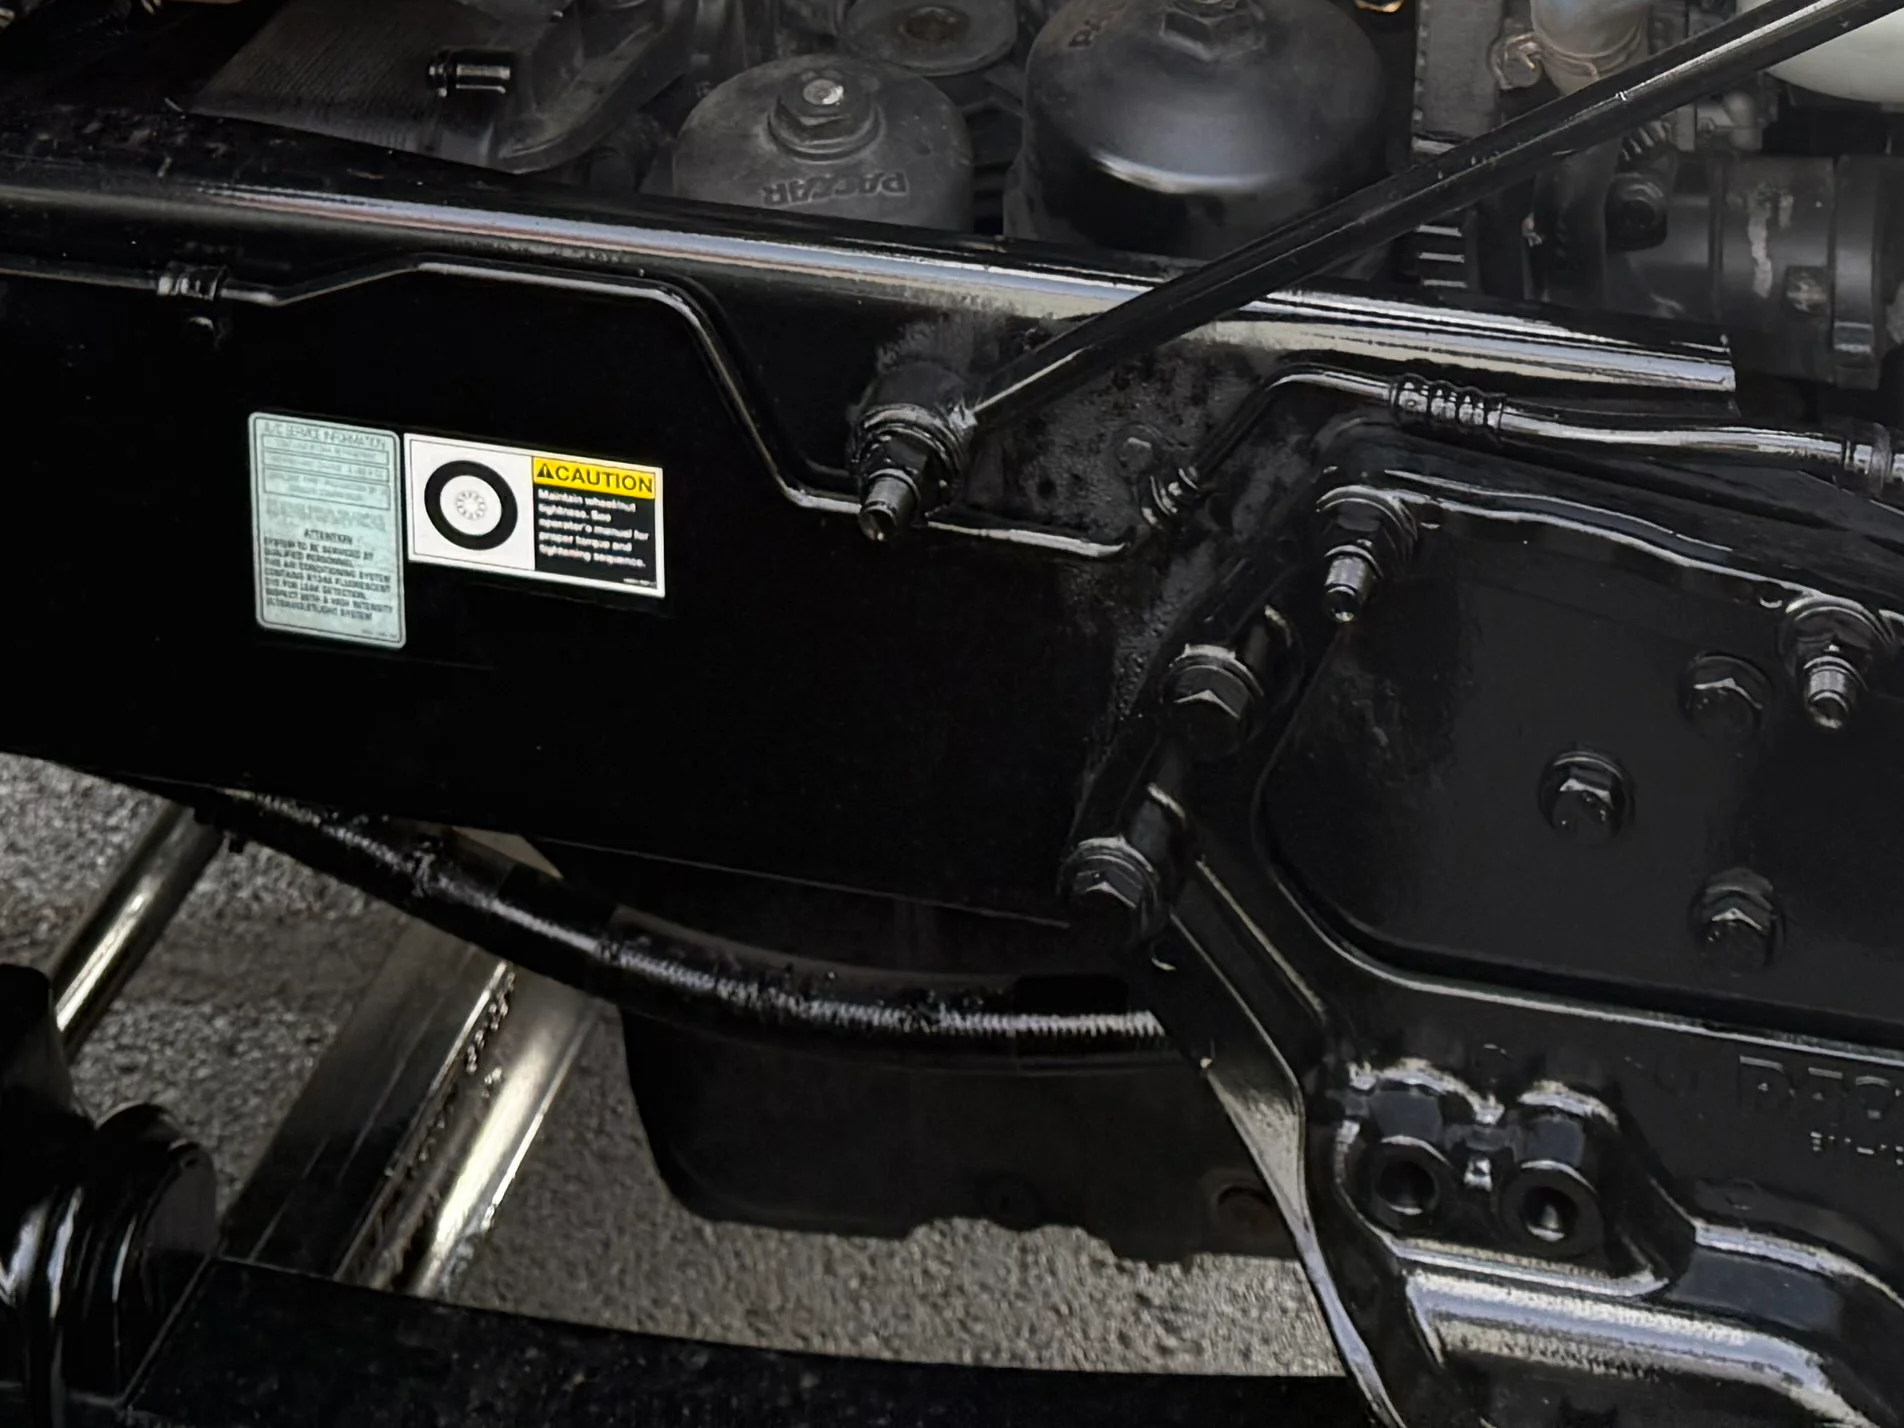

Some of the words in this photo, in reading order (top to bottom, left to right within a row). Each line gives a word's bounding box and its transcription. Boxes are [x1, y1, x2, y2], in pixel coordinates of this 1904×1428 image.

[762, 169, 910, 210] PACCAR
[322, 428, 386, 449] INFORMATION
[555, 465, 653, 493] CAUTION
[538, 488, 583, 504] Maintain
[538, 504, 590, 519] tightness.
[591, 510, 612, 523] See
[538, 519, 593, 533] operator's
[594, 525, 632, 539] manual
[634, 529, 650, 541] for
[538, 532, 574, 546] proper
[575, 535, 610, 550] torque
[611, 541, 633, 552] and
[538, 544, 592, 563] tightening
[593, 552, 646, 568] sequence.
[299, 562, 356, 578] CONDITIONING
